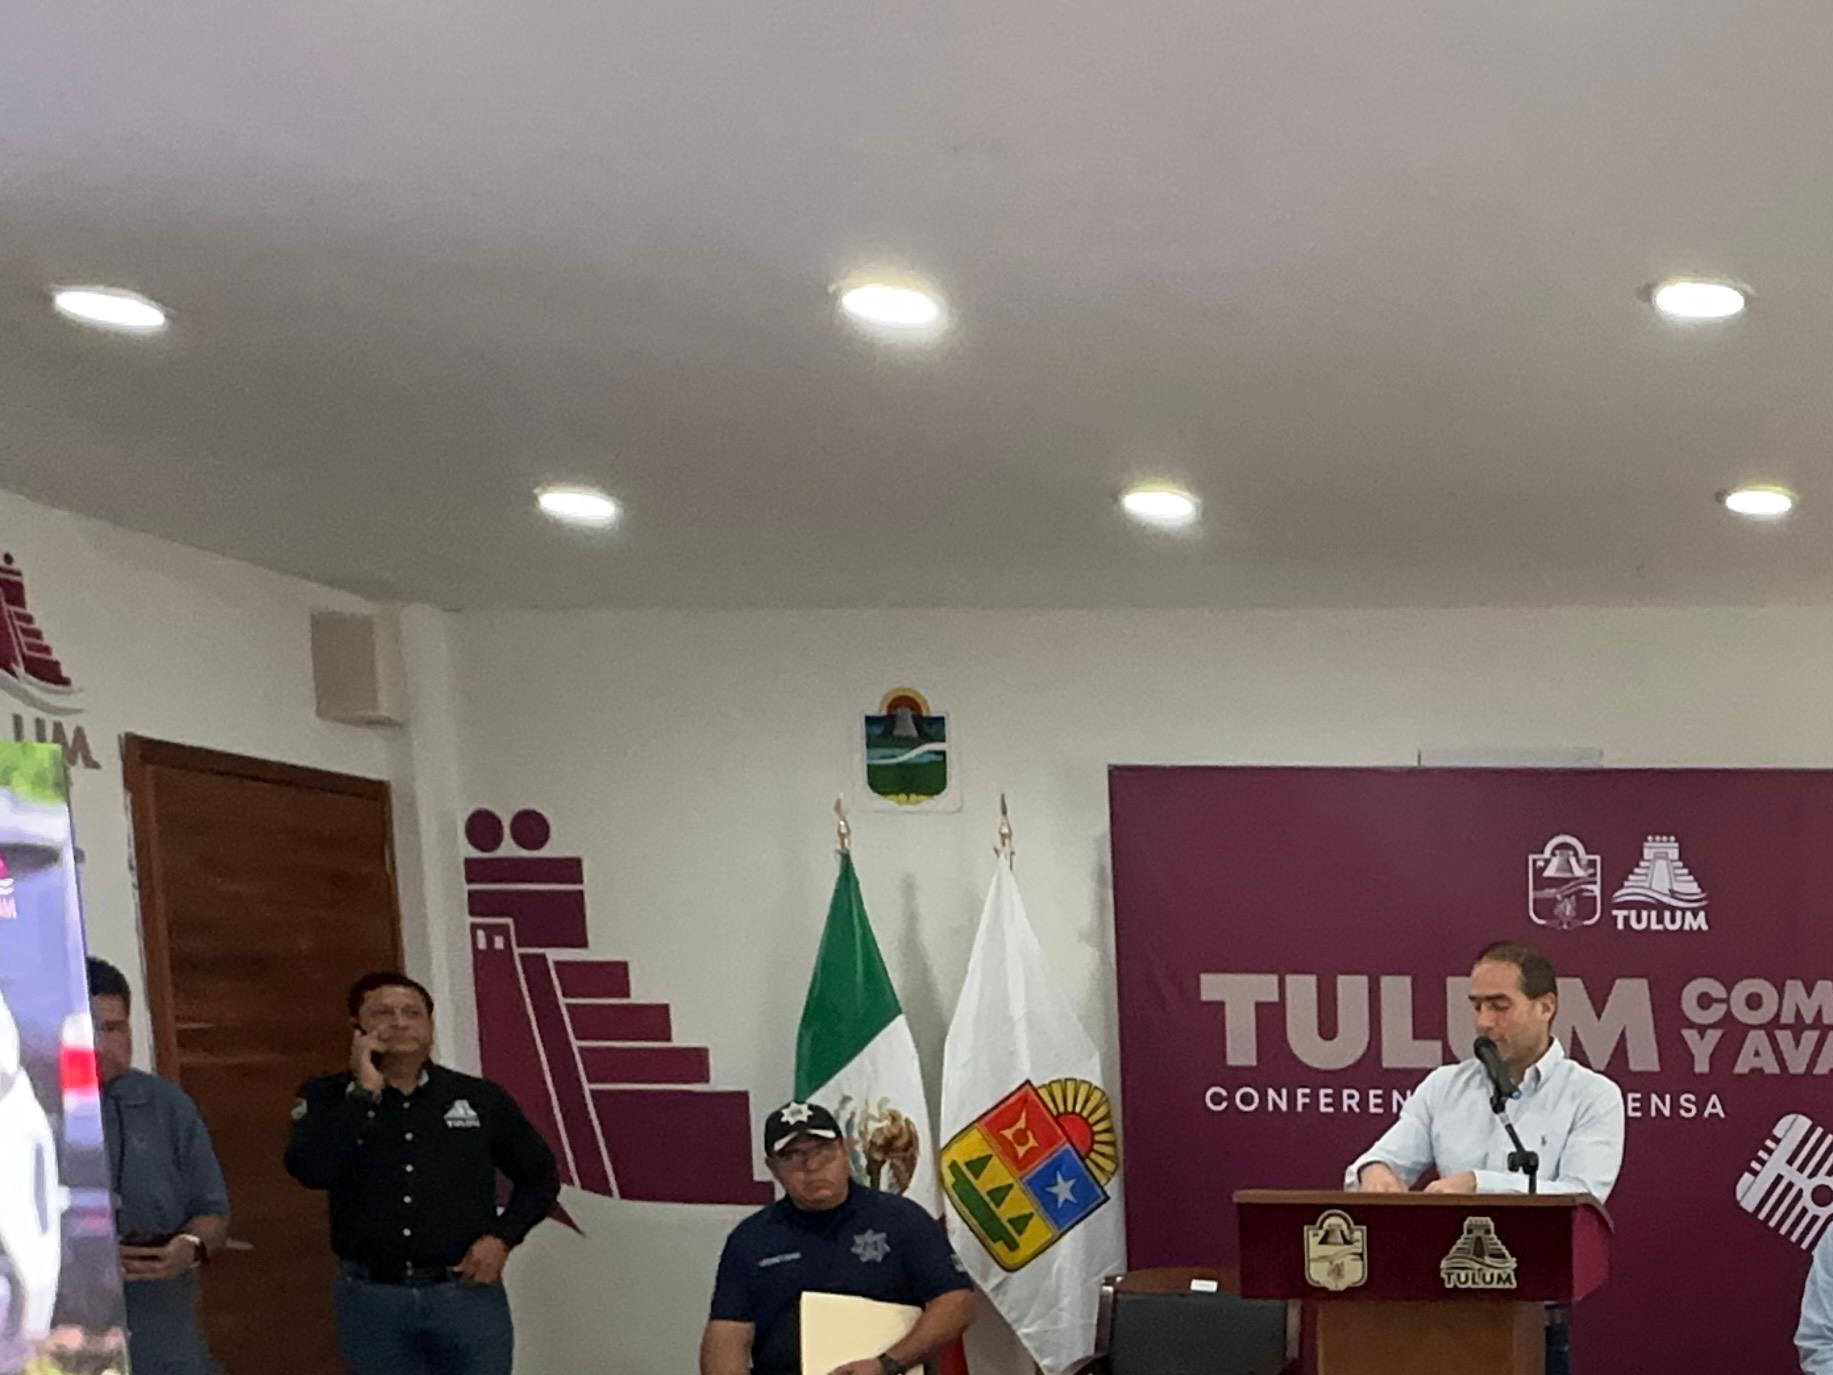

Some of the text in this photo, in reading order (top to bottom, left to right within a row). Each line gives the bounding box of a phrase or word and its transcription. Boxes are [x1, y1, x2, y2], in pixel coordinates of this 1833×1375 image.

[1611, 909, 1709, 931] TULUM
[1681, 1028, 1724, 1074] Y
[1204, 1086, 1725, 1119] CONFEREN ENSA
[1443, 1270, 1514, 1287] TULUM
